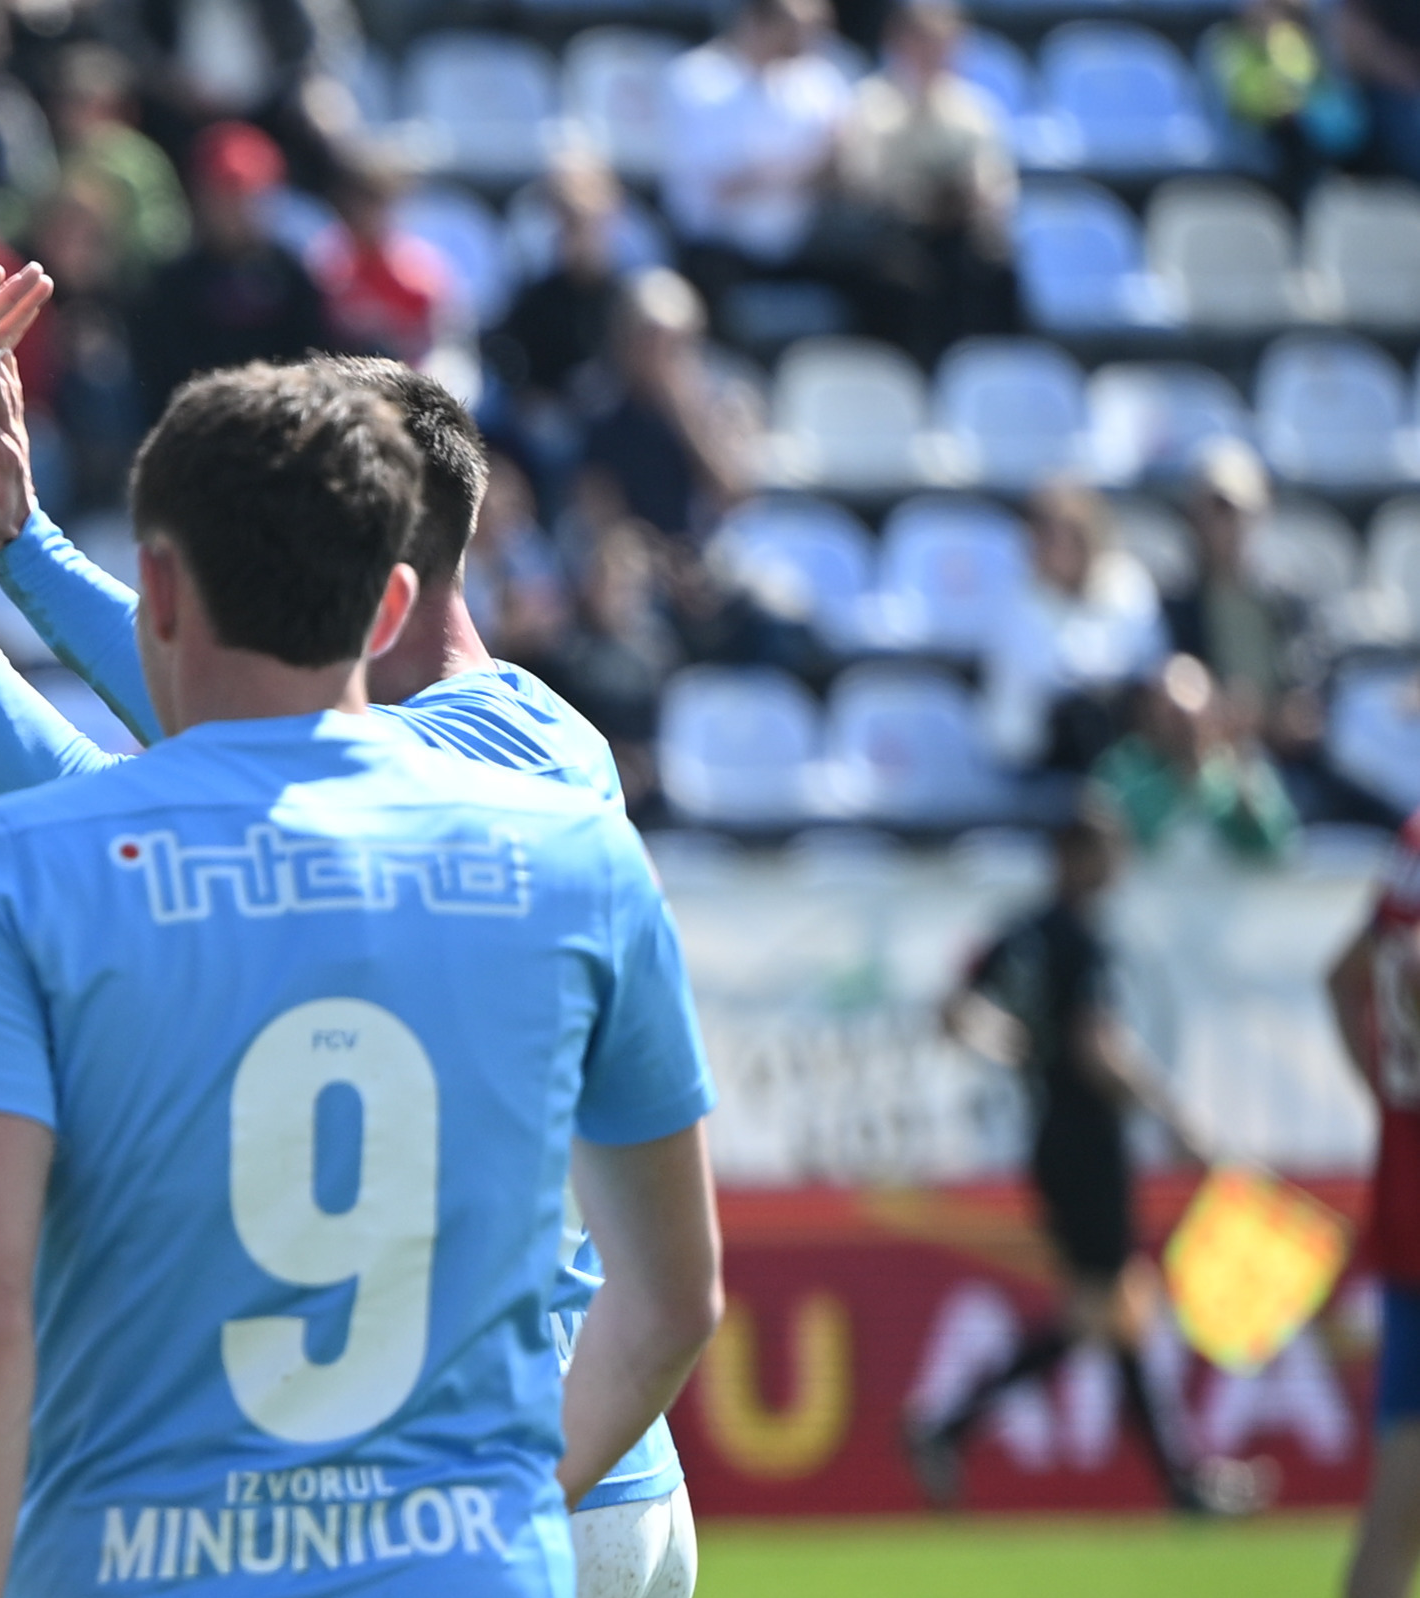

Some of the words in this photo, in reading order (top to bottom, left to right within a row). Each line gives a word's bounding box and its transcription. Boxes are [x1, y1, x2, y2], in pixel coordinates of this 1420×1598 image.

[312, 1028, 359, 1052] FCV
[220, 996, 440, 1445] 9
[227, 1464, 395, 1504] IZVORUL
[96, 1485, 511, 1586] MINUNILOR
